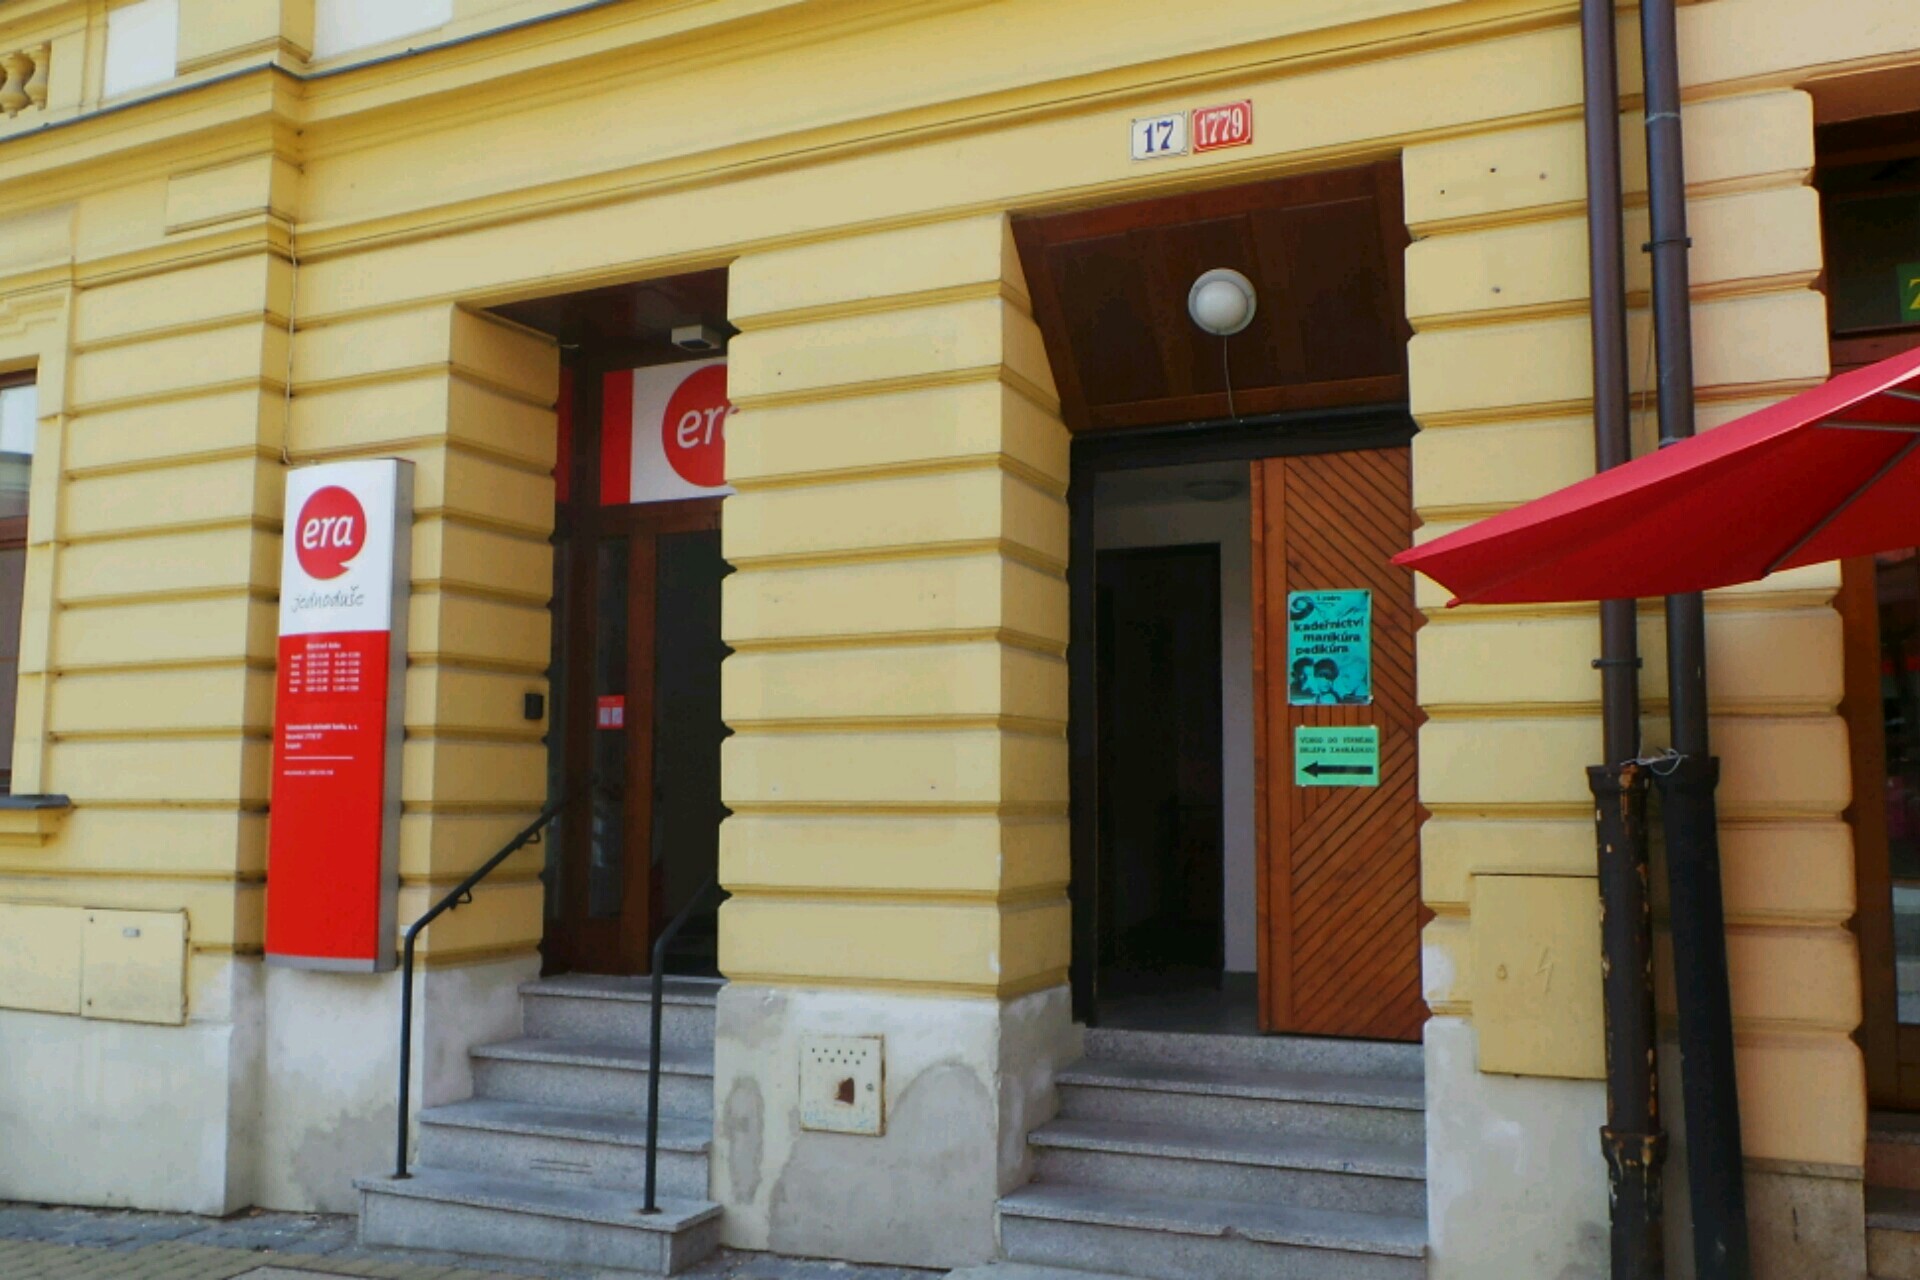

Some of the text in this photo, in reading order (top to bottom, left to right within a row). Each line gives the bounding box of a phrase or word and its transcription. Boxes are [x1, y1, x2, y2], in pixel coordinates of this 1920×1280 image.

[1144, 120, 1173, 153] 17
[1200, 108, 1243, 145] 1779
[677, 405, 738, 449] er
[302, 515, 354, 550] era
[291, 584, 365, 613] jednoduše
[1294, 616, 1364, 632] kadeřnictví
[1303, 631, 1361, 642] manikúra
[1296, 641, 1349, 656] pedikúra
